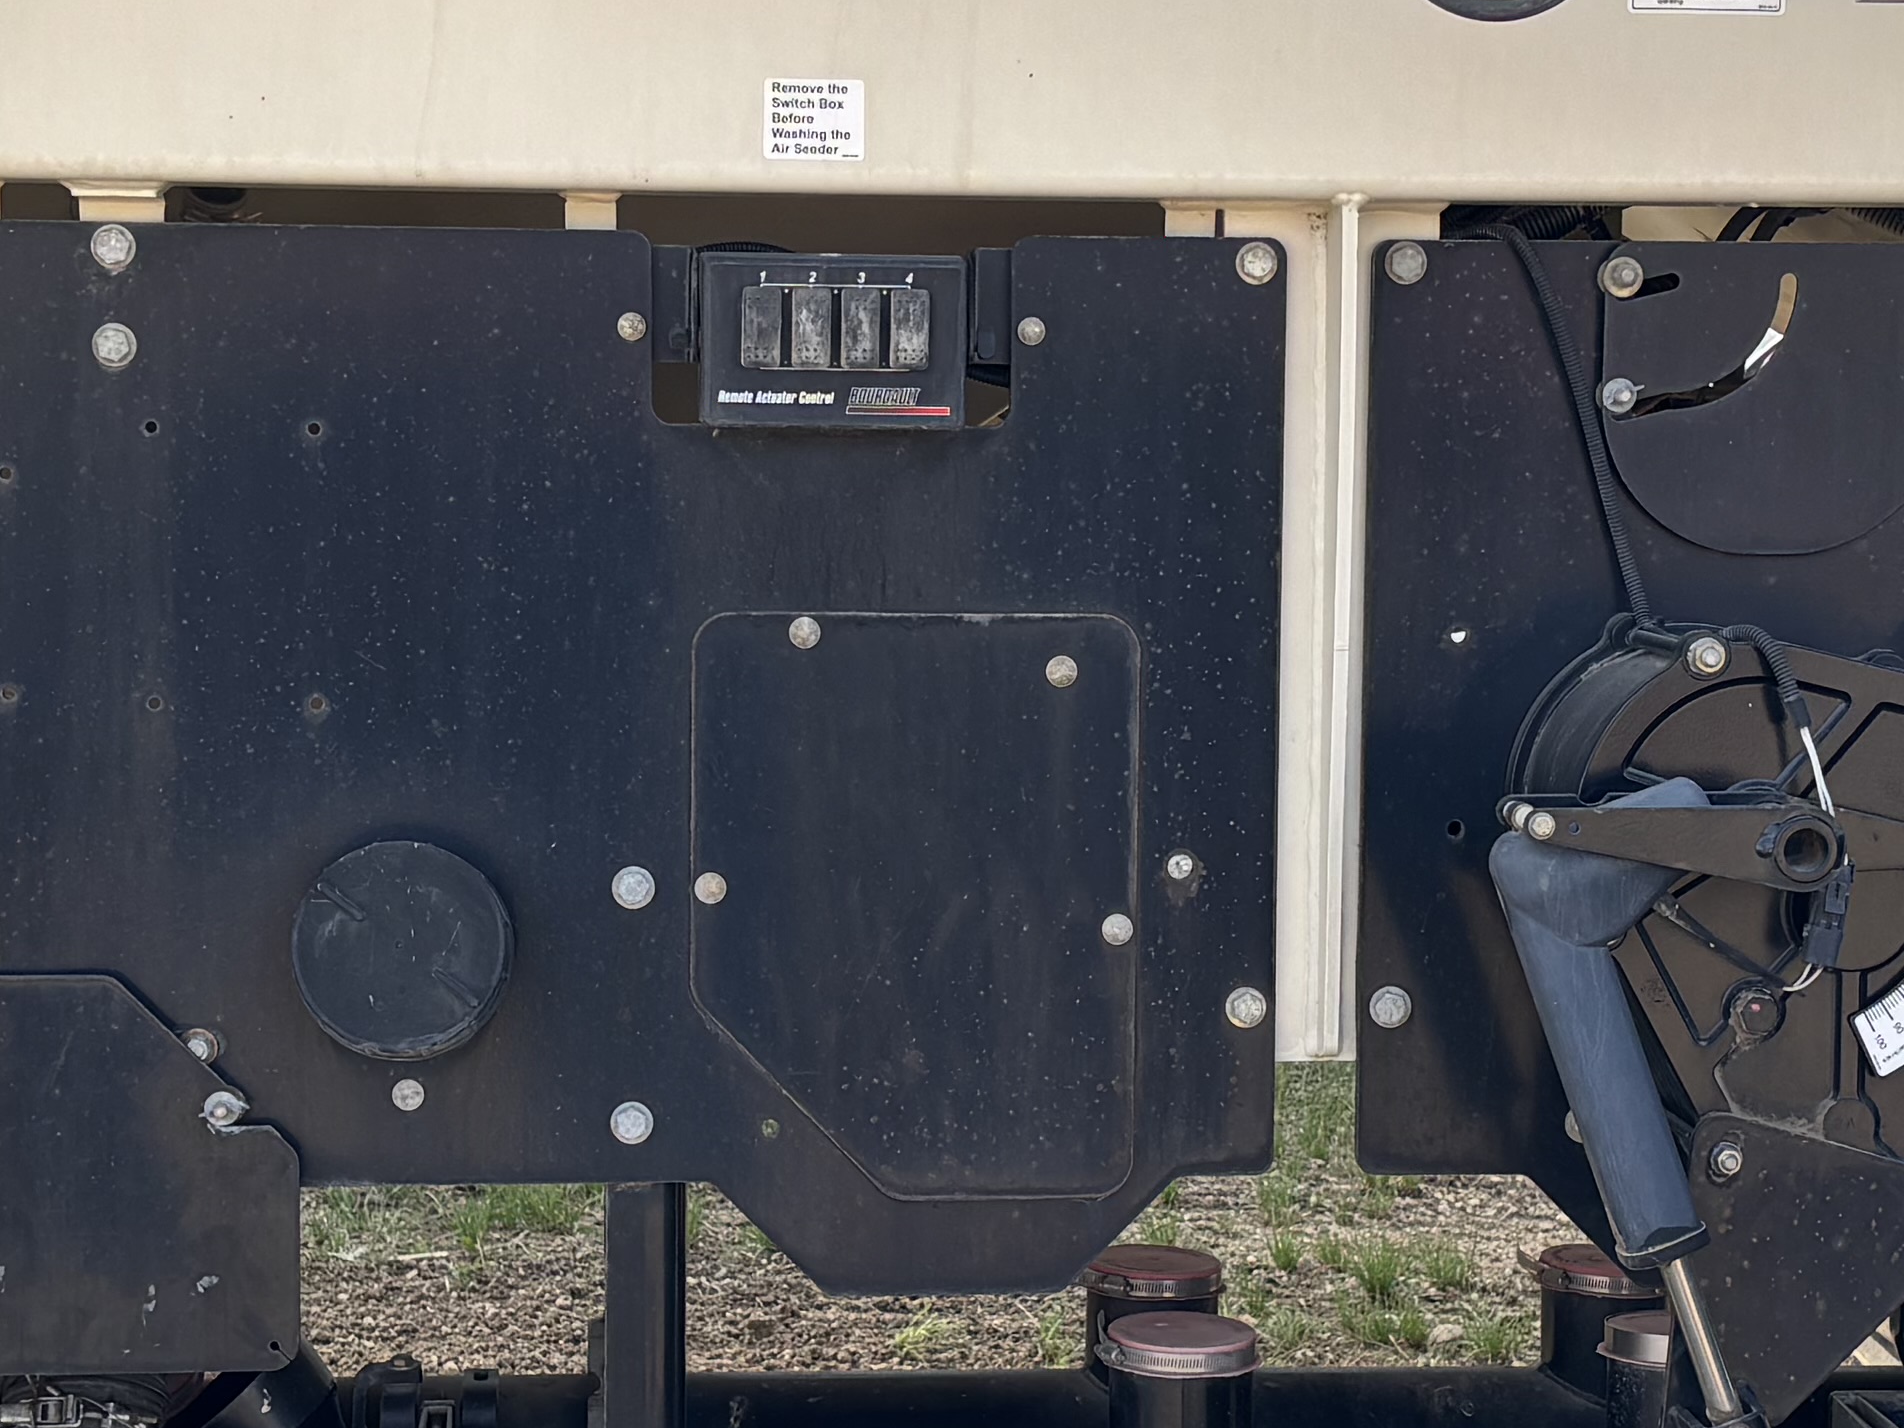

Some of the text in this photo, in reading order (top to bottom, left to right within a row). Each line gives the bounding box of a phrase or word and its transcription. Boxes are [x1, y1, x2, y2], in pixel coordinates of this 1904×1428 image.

[772, 82, 848, 94] Remove the
[772, 98, 844, 109] Switch Box
[772, 112, 814, 124] Before
[771, 128, 851, 142] Washing the
[771, 143, 839, 155] Air Seeder
[759, 270, 914, 284] 1 2 3 4
[717, 389, 754, 404] Remote
[754, 390, 797, 405] Actuator
[798, 390, 835, 405] Control
[1874, 1033, 1888, 1050] 100
